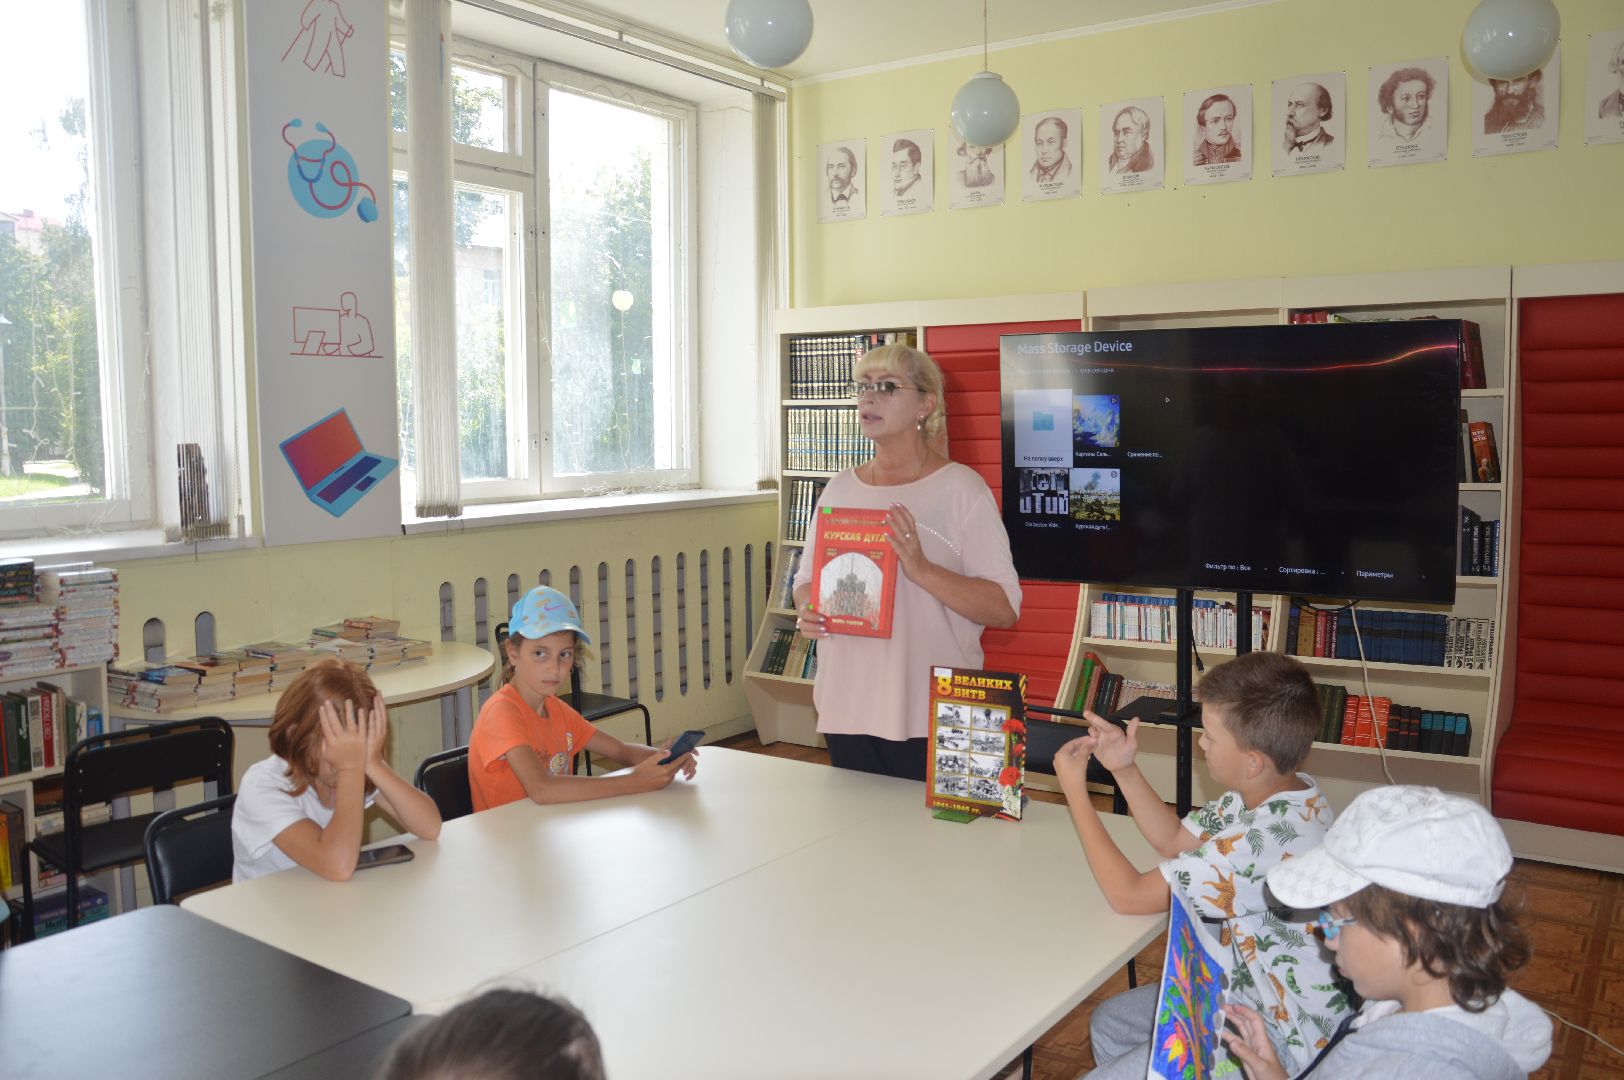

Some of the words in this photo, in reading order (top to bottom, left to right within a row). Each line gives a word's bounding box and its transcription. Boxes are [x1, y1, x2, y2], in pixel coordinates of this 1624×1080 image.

[1017, 343, 1046, 354] Mass
[1047, 342, 1092, 356] Storage
[1094, 340, 1133, 353] Device
[823, 530, 862, 542] КУРСКАЯ
[863, 533, 887, 543] ДУГА
[1205, 563, 1228, 571] Фильтр
[1278, 566, 1316, 575] Сортировка
[1356, 570, 1394, 579] Параметры
[936, 675, 953, 697] 8
[953, 675, 1013, 691] ВЕЛИКИХ
[953, 688, 986, 700] БИТВ
